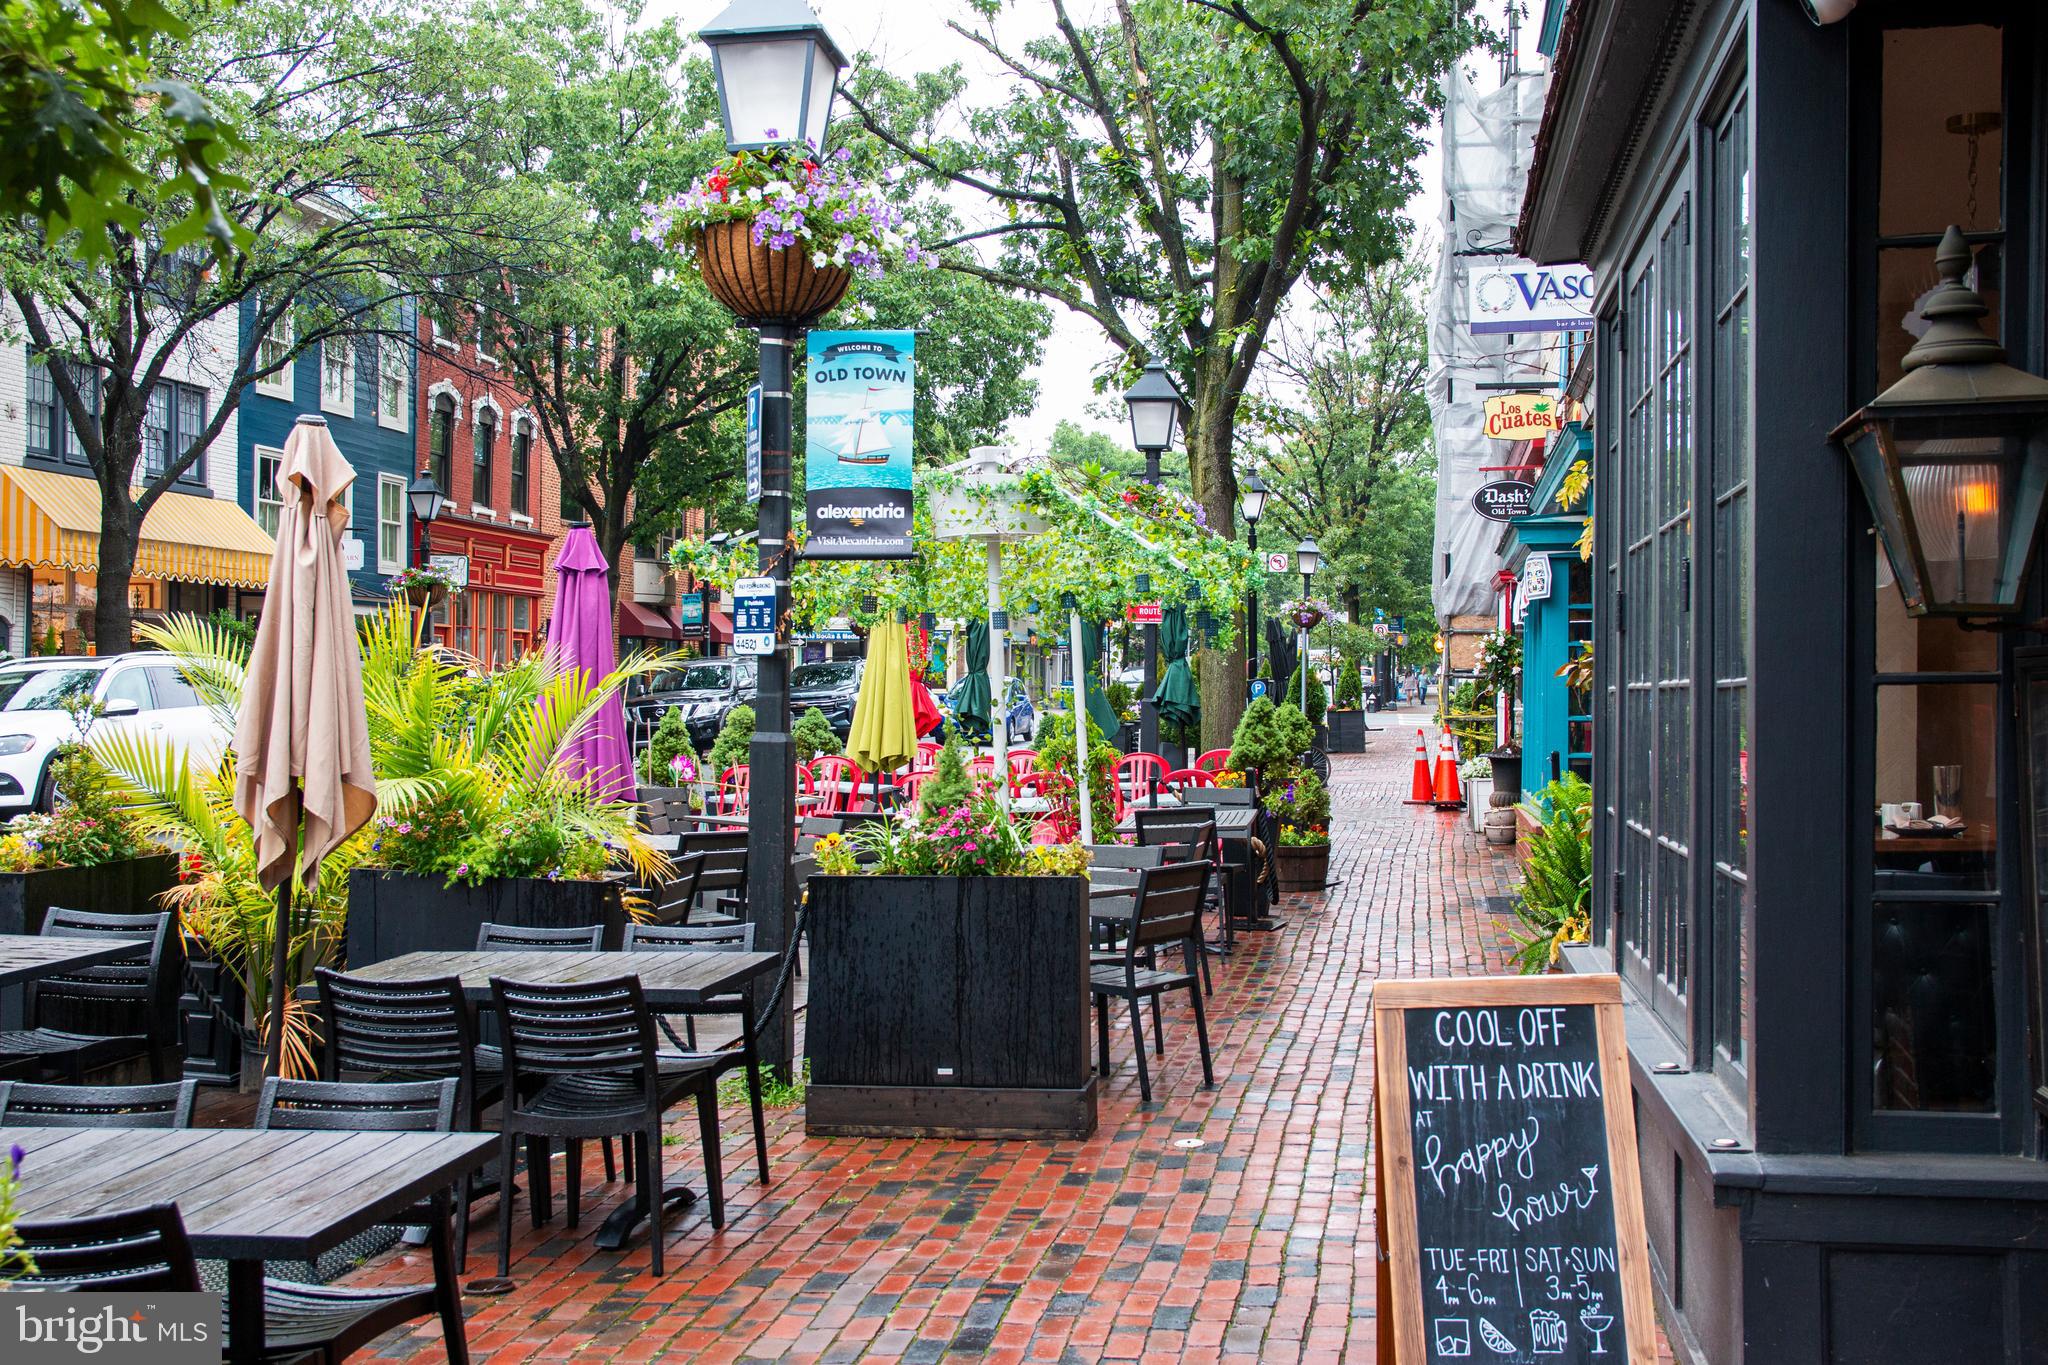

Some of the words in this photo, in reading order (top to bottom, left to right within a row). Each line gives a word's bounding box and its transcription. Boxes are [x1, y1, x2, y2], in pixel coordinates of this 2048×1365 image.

[838, 344, 872, 353] WELCOME
[815, 368, 848, 384] OLD
[853, 367, 906, 383] TOWN
[1501, 401, 1521, 415] Los
[1489, 410, 1551, 435] Cuates
[816, 502, 905, 519] alexandria
[1491, 507, 1506, 515] Old
[1507, 507, 1527, 515] Town
[817, 535, 904, 547] VisitAlexandria.com
[1139, 607, 1161, 615] ROUTE
[1255, 684, 1262, 694] P
[1435, 1009, 1512, 1046] COOL
[1519, 1008, 1566, 1046] OFF
[1408, 1064, 1487, 1100] WITH
[1497, 1064, 1515, 1100] A
[1517, 1061, 1600, 1098] DRINK
[1415, 1111, 1433, 1127] AT
[1421, 1116, 1539, 1198] happy
[1492, 1183, 1594, 1231] hour
